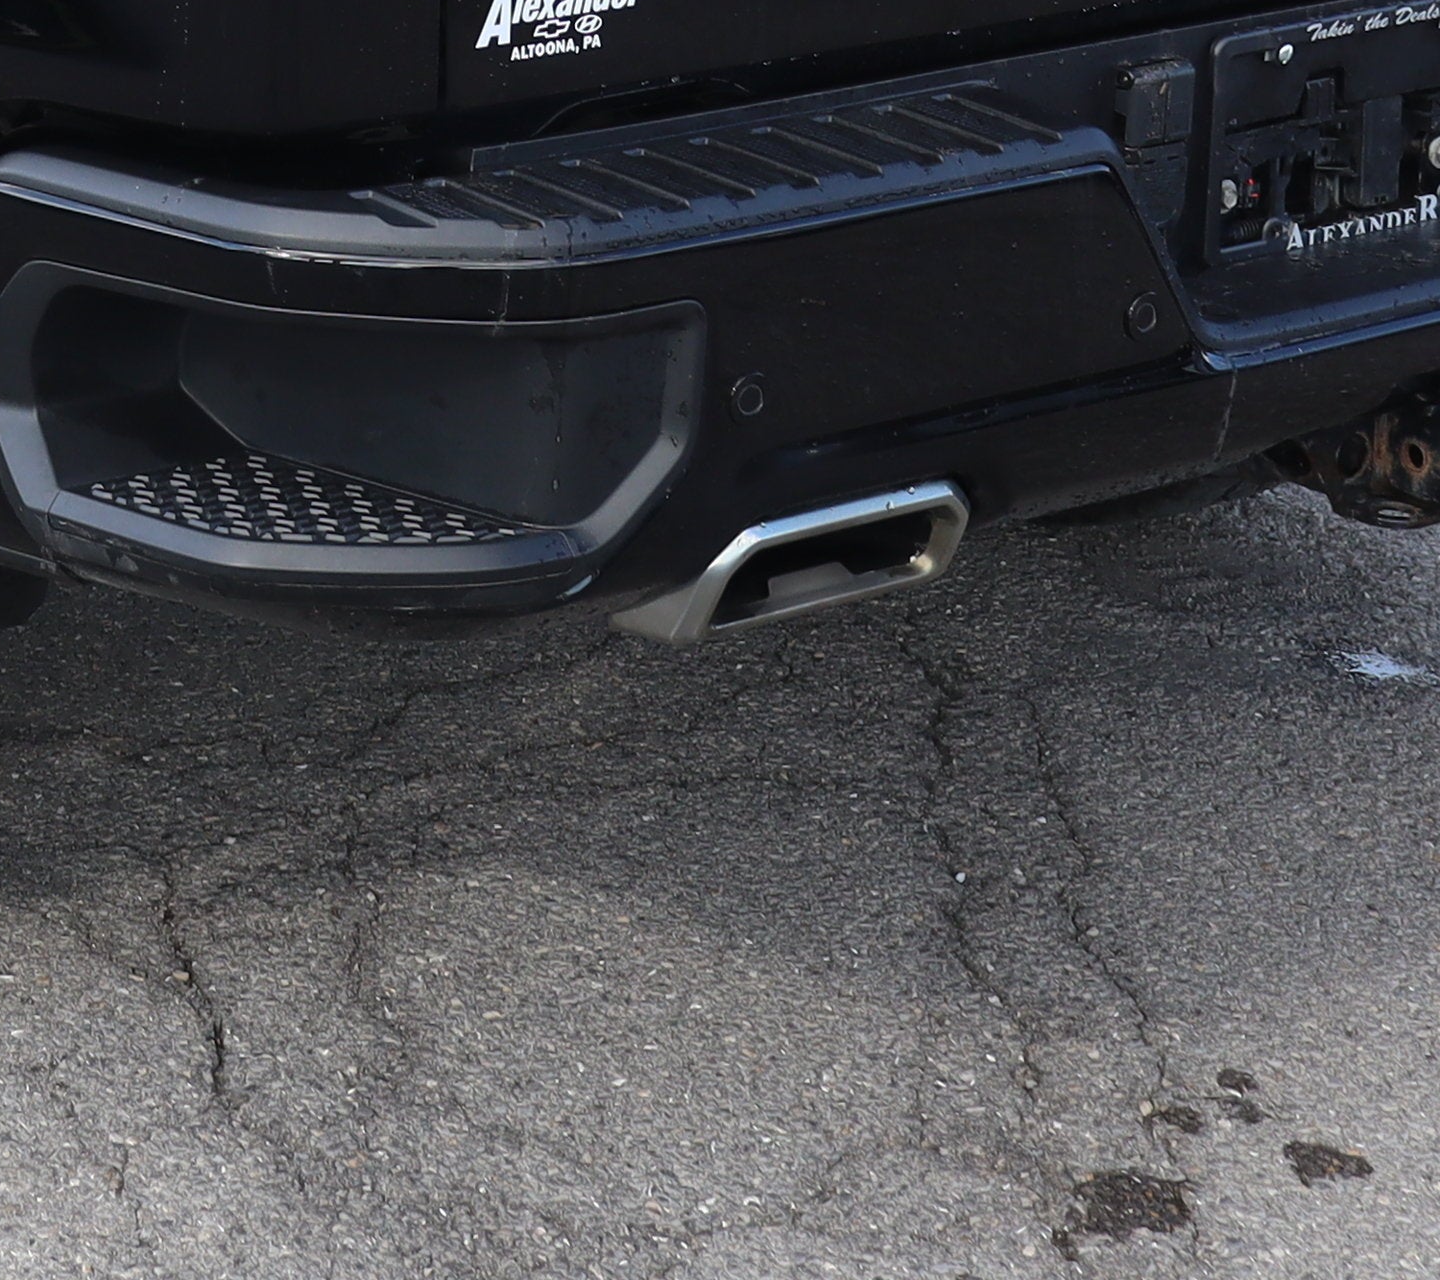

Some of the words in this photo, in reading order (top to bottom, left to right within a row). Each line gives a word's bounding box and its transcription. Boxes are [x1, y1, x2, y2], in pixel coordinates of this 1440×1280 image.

[1306, 15, 1361, 42] Takin'
[1364, 12, 1390, 32] the
[1395, 3, 1440, 26] Deals
[510, 37, 580, 61] ALTOONA,
[582, 33, 602, 50] PA
